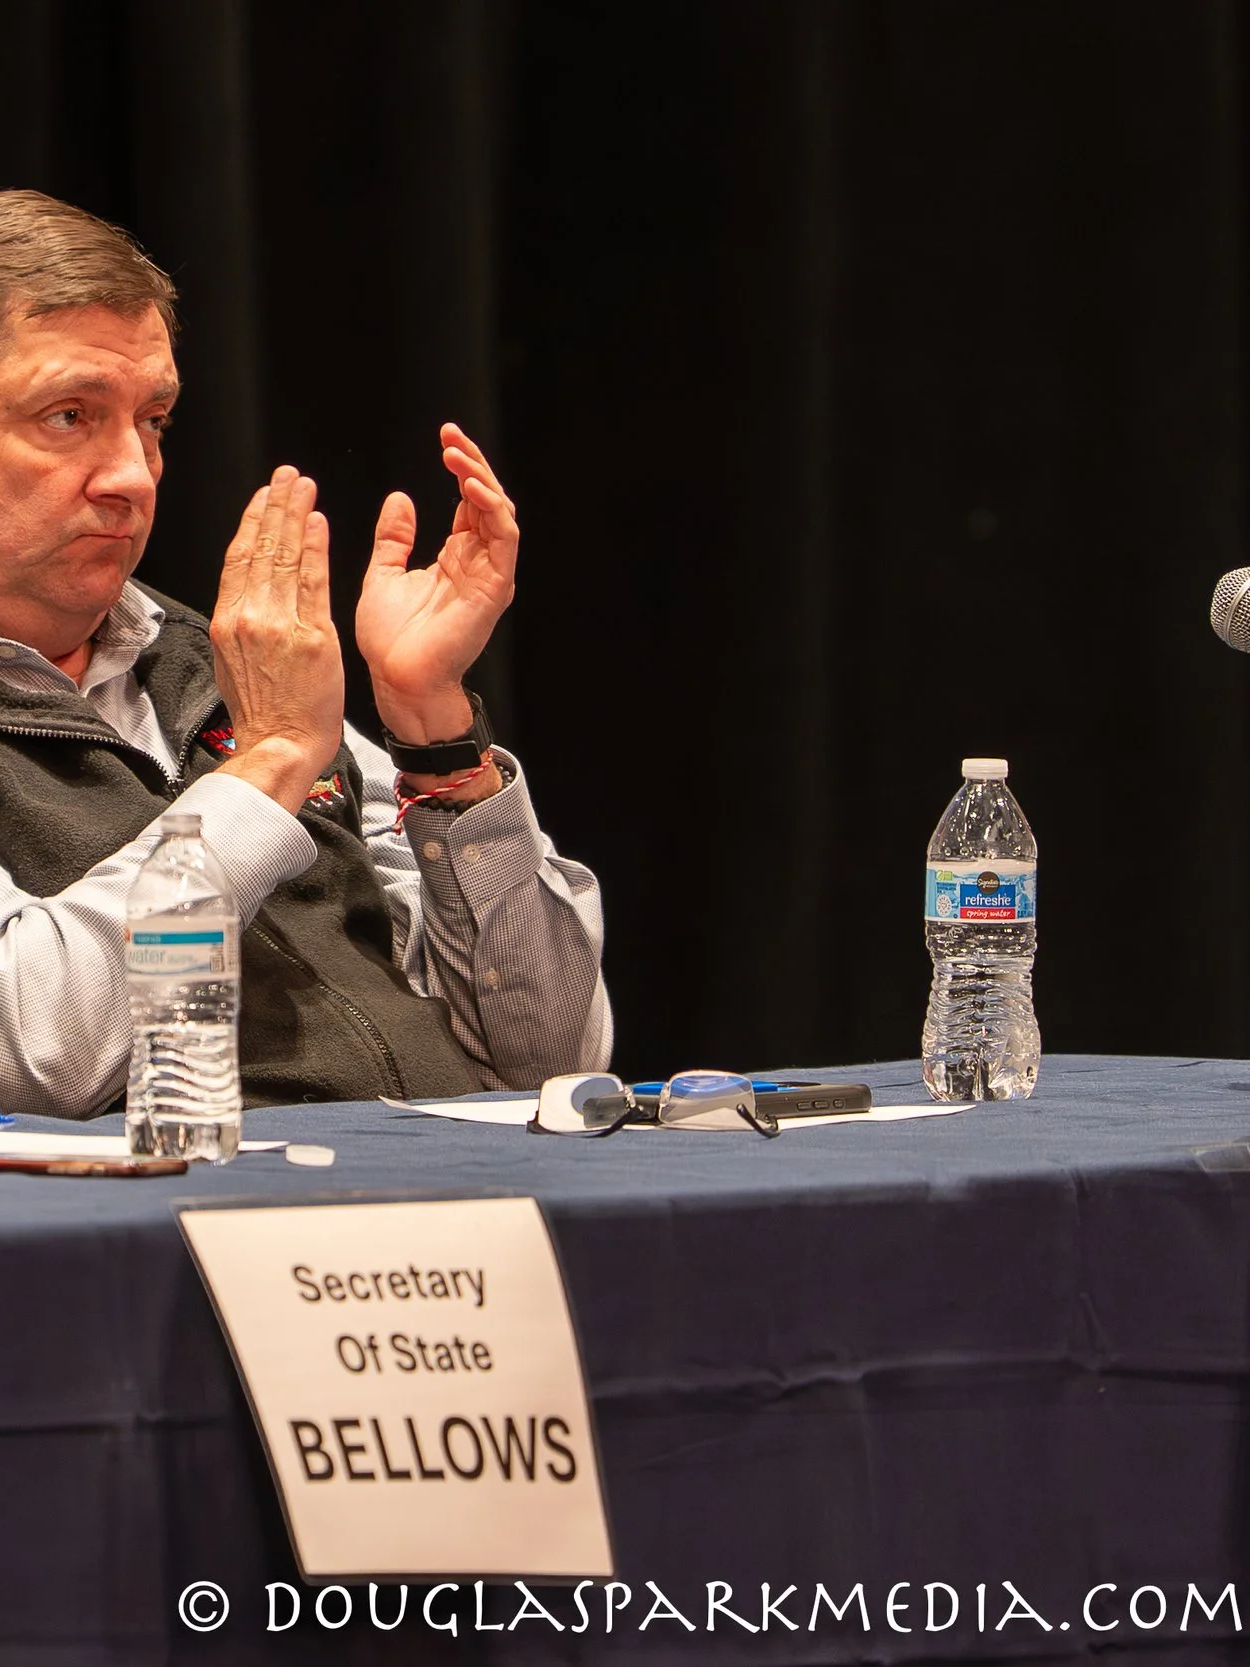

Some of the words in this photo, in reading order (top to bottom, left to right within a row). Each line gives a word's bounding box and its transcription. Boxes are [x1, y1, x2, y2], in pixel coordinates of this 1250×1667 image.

[291, 1264, 486, 1308] Secretary
[335, 1333, 384, 1374] Of
[390, 1332, 494, 1373] State
[289, 1415, 578, 1484] BELLOWS
